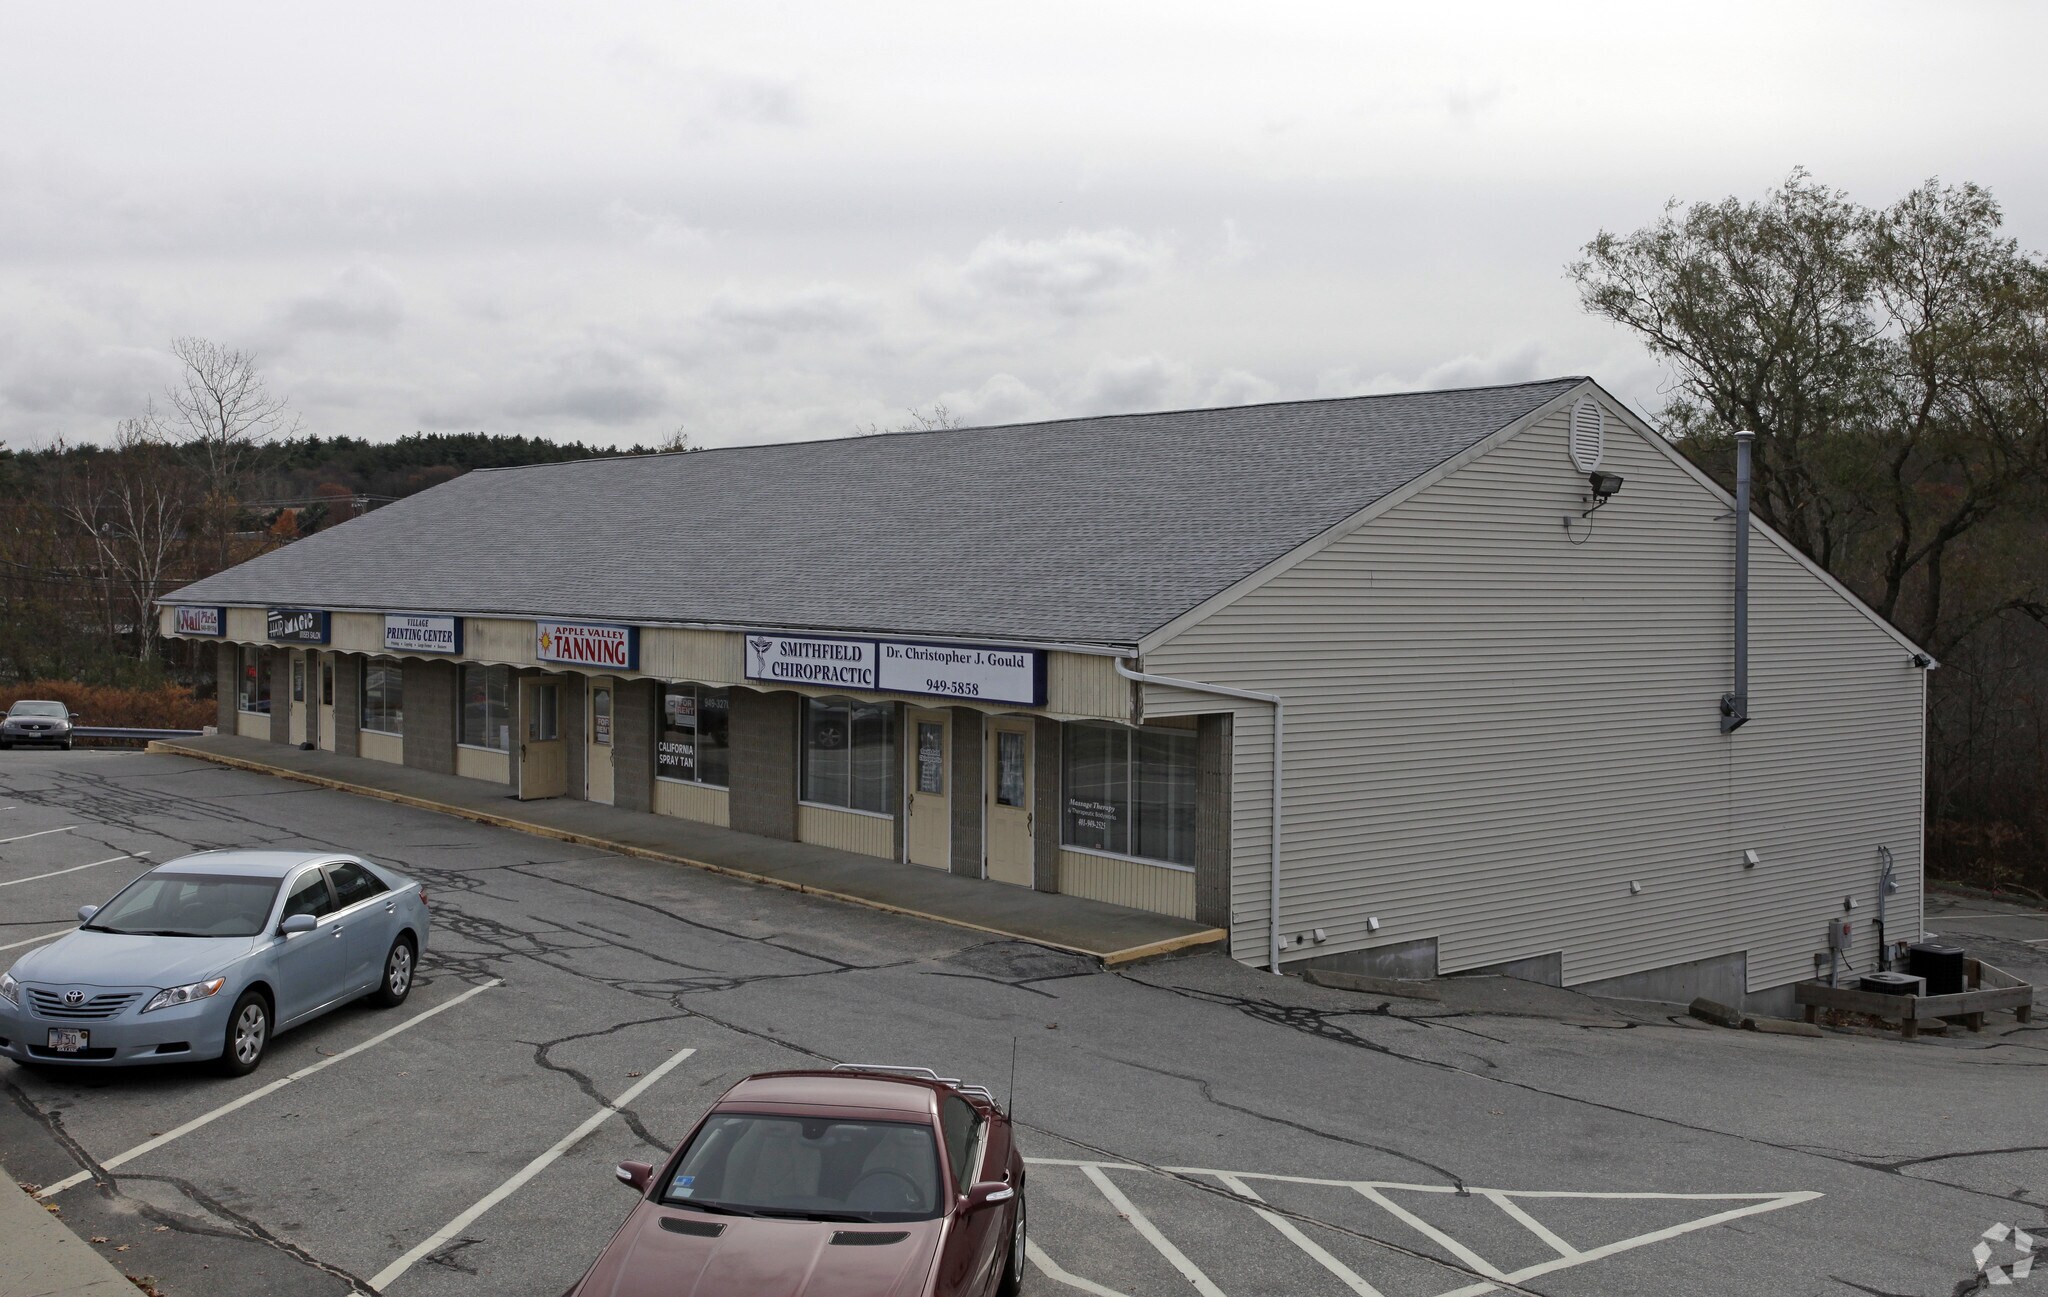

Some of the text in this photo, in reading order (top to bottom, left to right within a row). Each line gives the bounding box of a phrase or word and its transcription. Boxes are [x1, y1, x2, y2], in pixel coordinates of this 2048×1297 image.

[181, 609, 201, 631] Nail
[201, 611, 216, 624] Arts
[284, 612, 313, 634] MAGIC
[407, 618, 430, 627] VILLAGE
[386, 627, 453, 643] PRINTING CENTER
[555, 626, 624, 639] APPLE VALLEY
[554, 635, 626, 665] TANNING
[780, 641, 862, 662] SMITHFIELD
[886, 646, 1025, 668] Dr. Christopher J. Gould
[772, 661, 872, 685] CHIROPRACTIC
[926, 678, 979, 696] 949-5858
[679, 699, 693, 707] FOR
[658, 741, 694, 755] CALIFORNIA
[659, 754, 694, 768] SPRAY TAN
[1069, 798, 1116, 813] Massage Therapy
